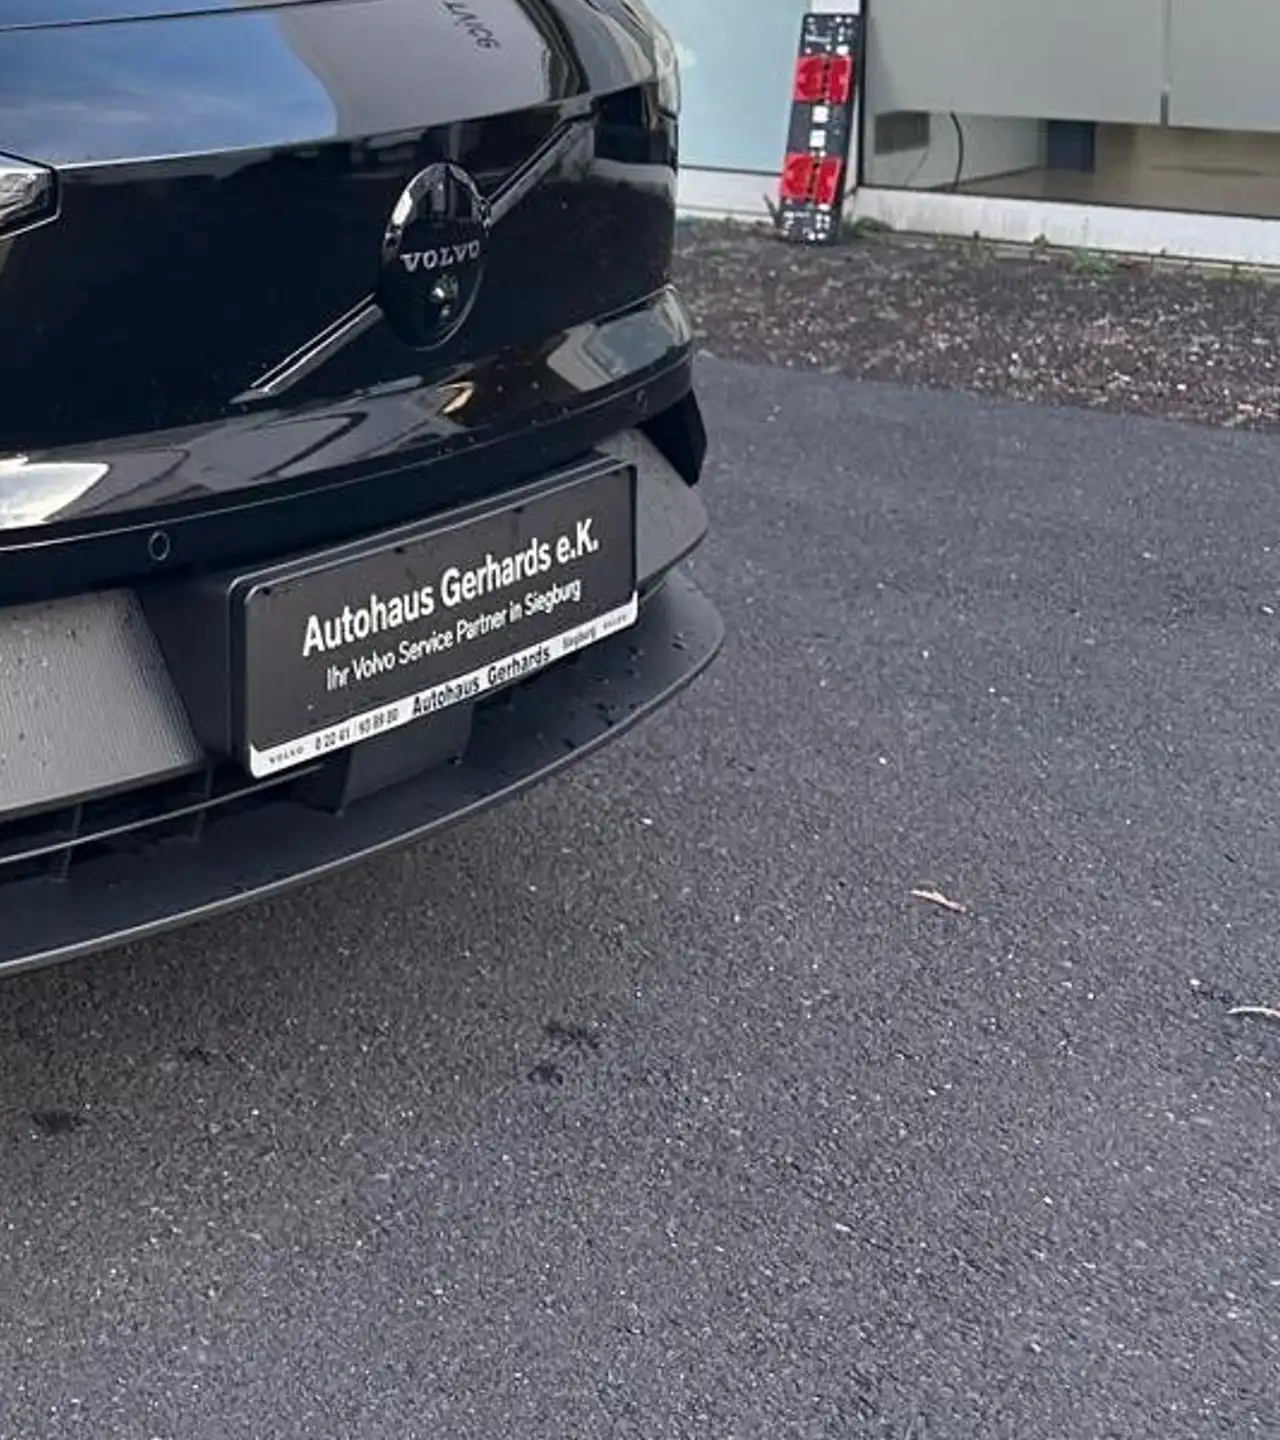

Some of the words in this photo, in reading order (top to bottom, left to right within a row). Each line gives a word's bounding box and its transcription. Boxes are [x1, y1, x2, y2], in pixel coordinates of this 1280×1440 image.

[400, 240, 480, 272] VOLVO
[303, 585, 434, 657] Autohaus
[441, 538, 551, 607] Gerhards
[556, 518, 599, 563] e.K.
[327, 665, 351, 691] Ihr
[352, 649, 396, 681] Volvo
[398, 629, 454, 664] Service
[457, 609, 508, 644] Partner
[509, 601, 523, 622] in
[524, 579, 581, 616] Siegburg
[411, 676, 481, 716] Autohaus
[488, 645, 551, 685] Gerhards
